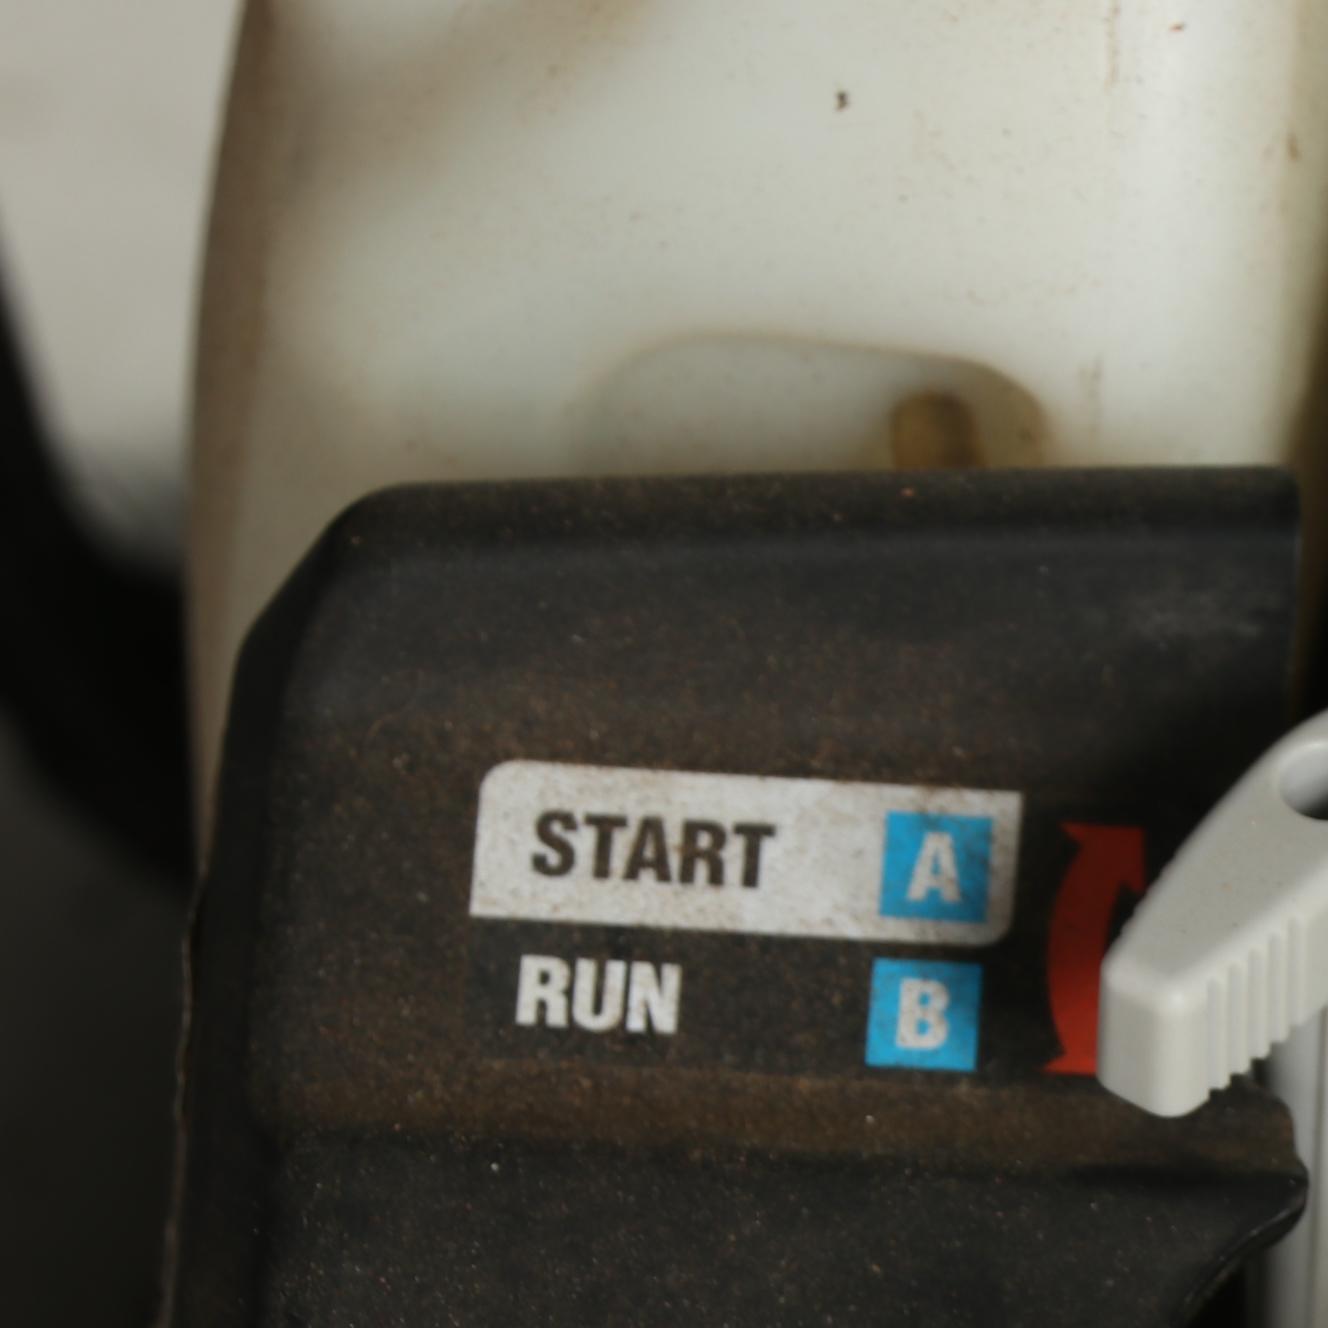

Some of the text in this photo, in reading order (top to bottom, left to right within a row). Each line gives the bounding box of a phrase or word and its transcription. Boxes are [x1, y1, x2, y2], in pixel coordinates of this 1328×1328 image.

[532, 810, 962, 904] START A
[516, 954, 950, 1051] RUN B
